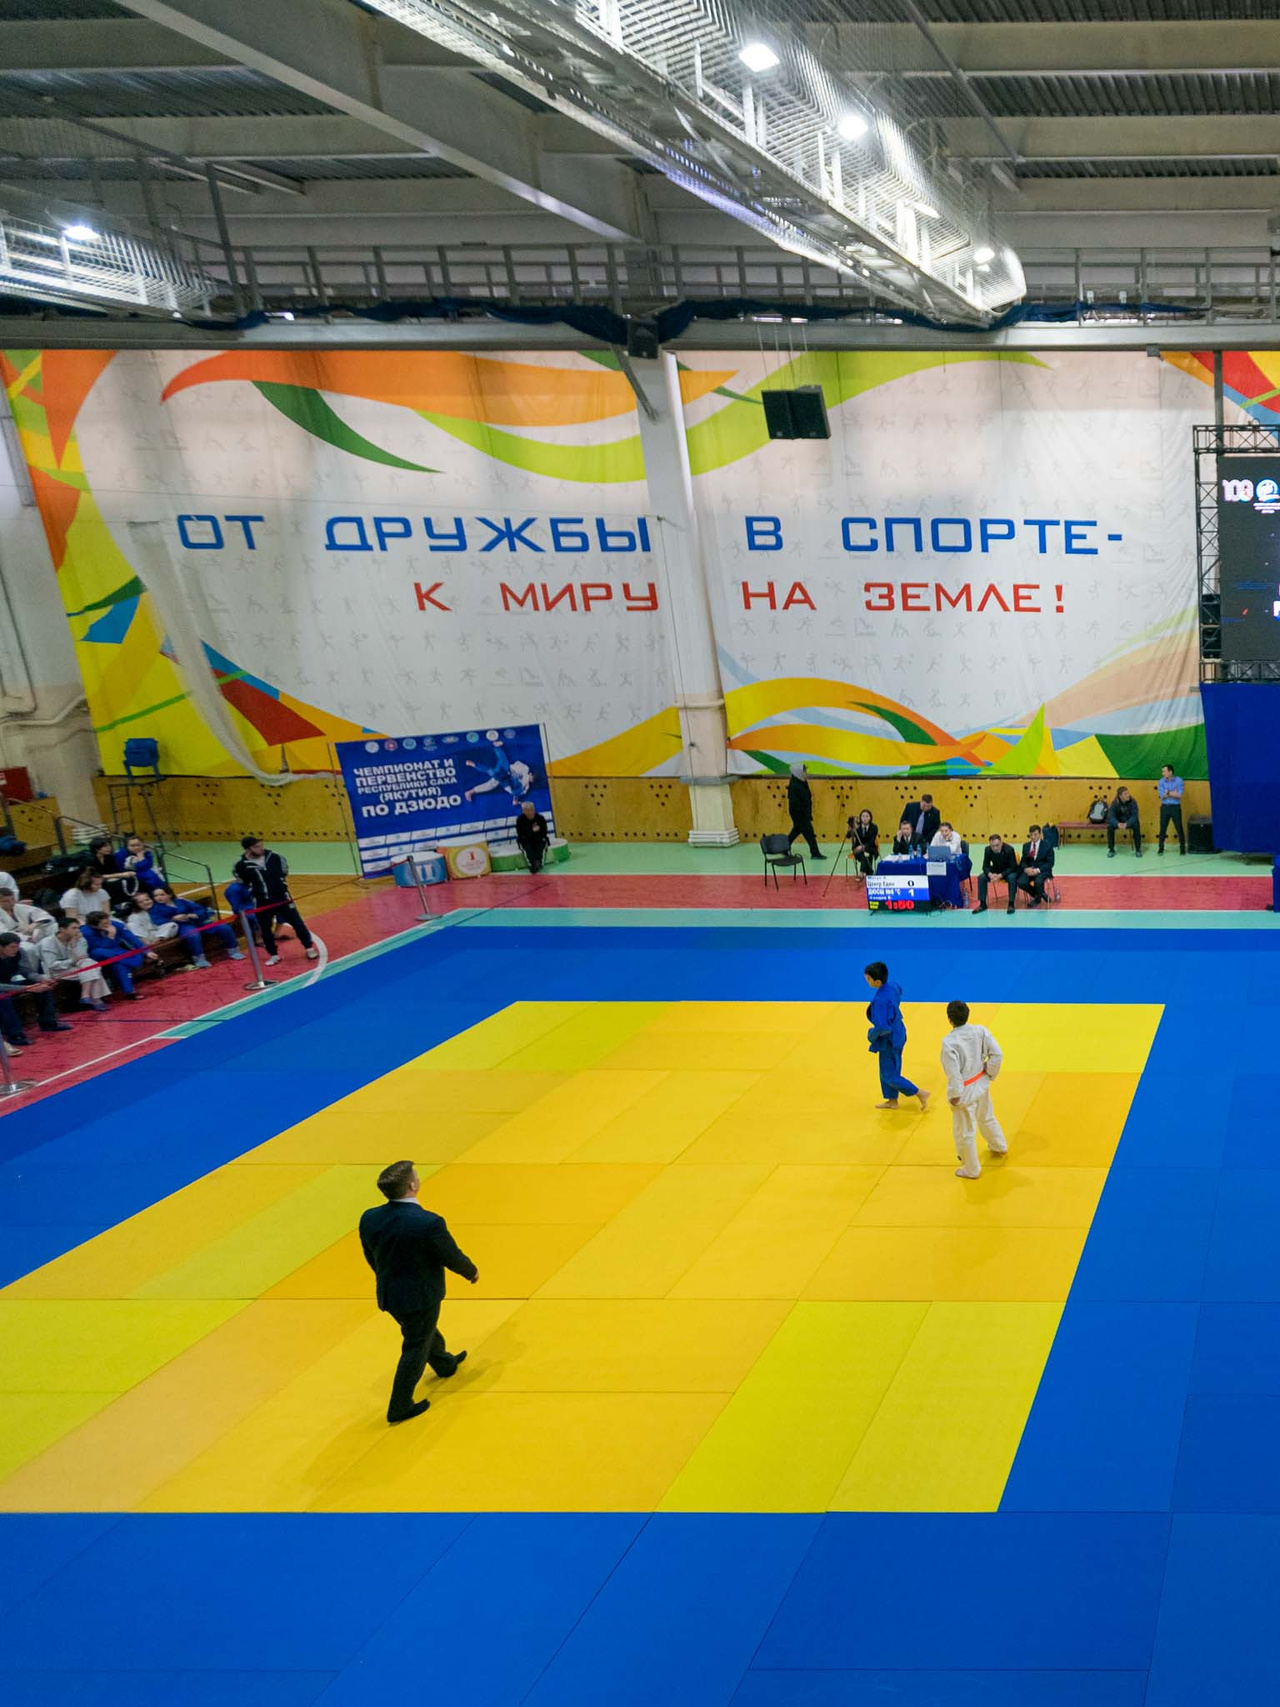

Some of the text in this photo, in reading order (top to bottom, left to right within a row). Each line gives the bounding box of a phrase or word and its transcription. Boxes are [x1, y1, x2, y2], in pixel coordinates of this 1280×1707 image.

[176, 514, 264, 550] ОТ
[324, 516, 651, 552] ДРУЖБЫ
[745, 516, 783, 551] В
[413, 581, 1065, 613] К МИРУ НА ЗЕМЛЕ!
[353, 758, 454, 777] ЧЕМПИОНАТ И
[355, 767, 456, 787] ПЕРВЕНСТВО
[357, 777, 457, 795] РЕСПУБЛИКИ САХА
[379, 786, 442, 803] (ЯКУТИЯ)
[362, 794, 462, 818] ПО ДЗЮДО
[908, 889, 915, 897] 1
